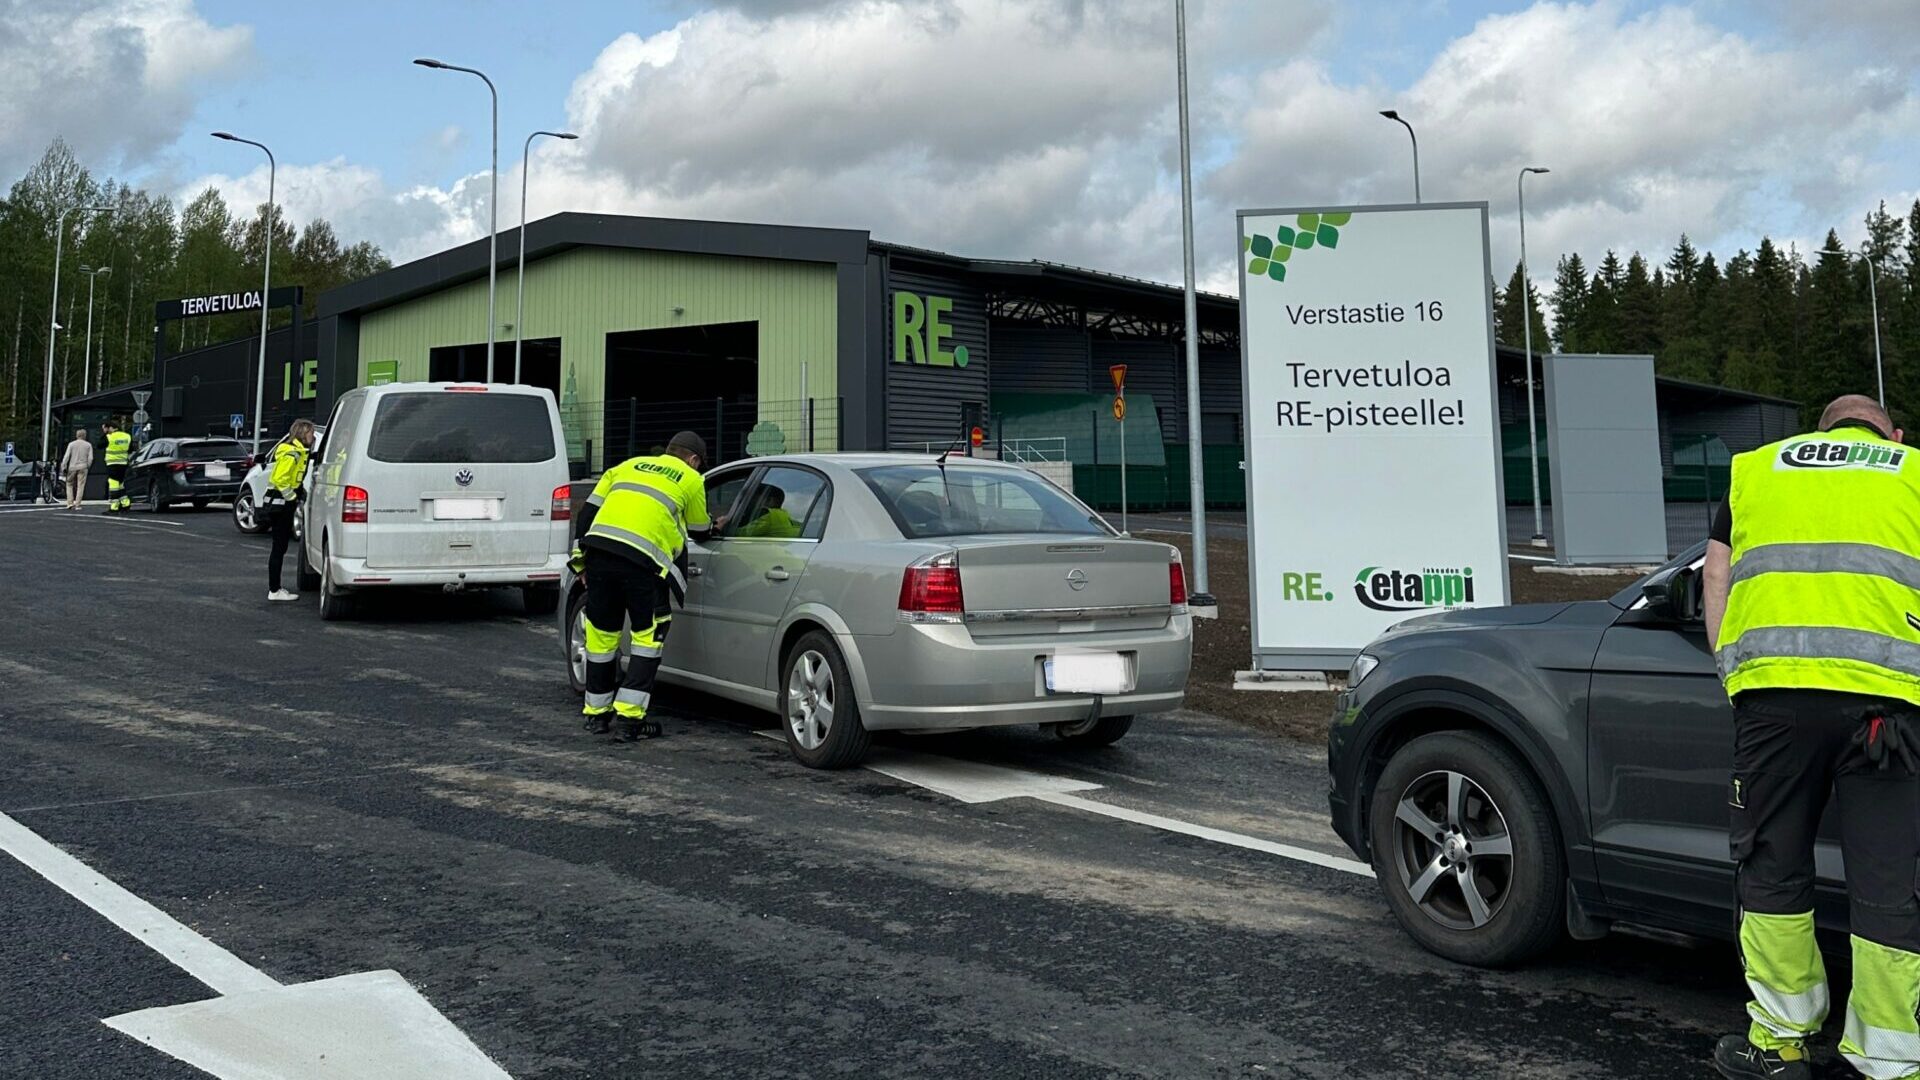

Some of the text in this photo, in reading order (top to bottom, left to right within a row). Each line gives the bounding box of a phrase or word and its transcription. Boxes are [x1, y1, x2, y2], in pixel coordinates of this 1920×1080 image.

[181, 292, 262, 315] TERVETULOA
[1286, 301, 1443, 325] Verstastie 16
[894, 291, 970, 368] RE.
[1286, 360, 1451, 389] Tervetuloa
[1276, 398, 1465, 433] RE-pisteelle!
[1796, 442, 1905, 466] etappi
[641, 463, 685, 483] etappi
[1282, 566, 1474, 606] RE. etappi
